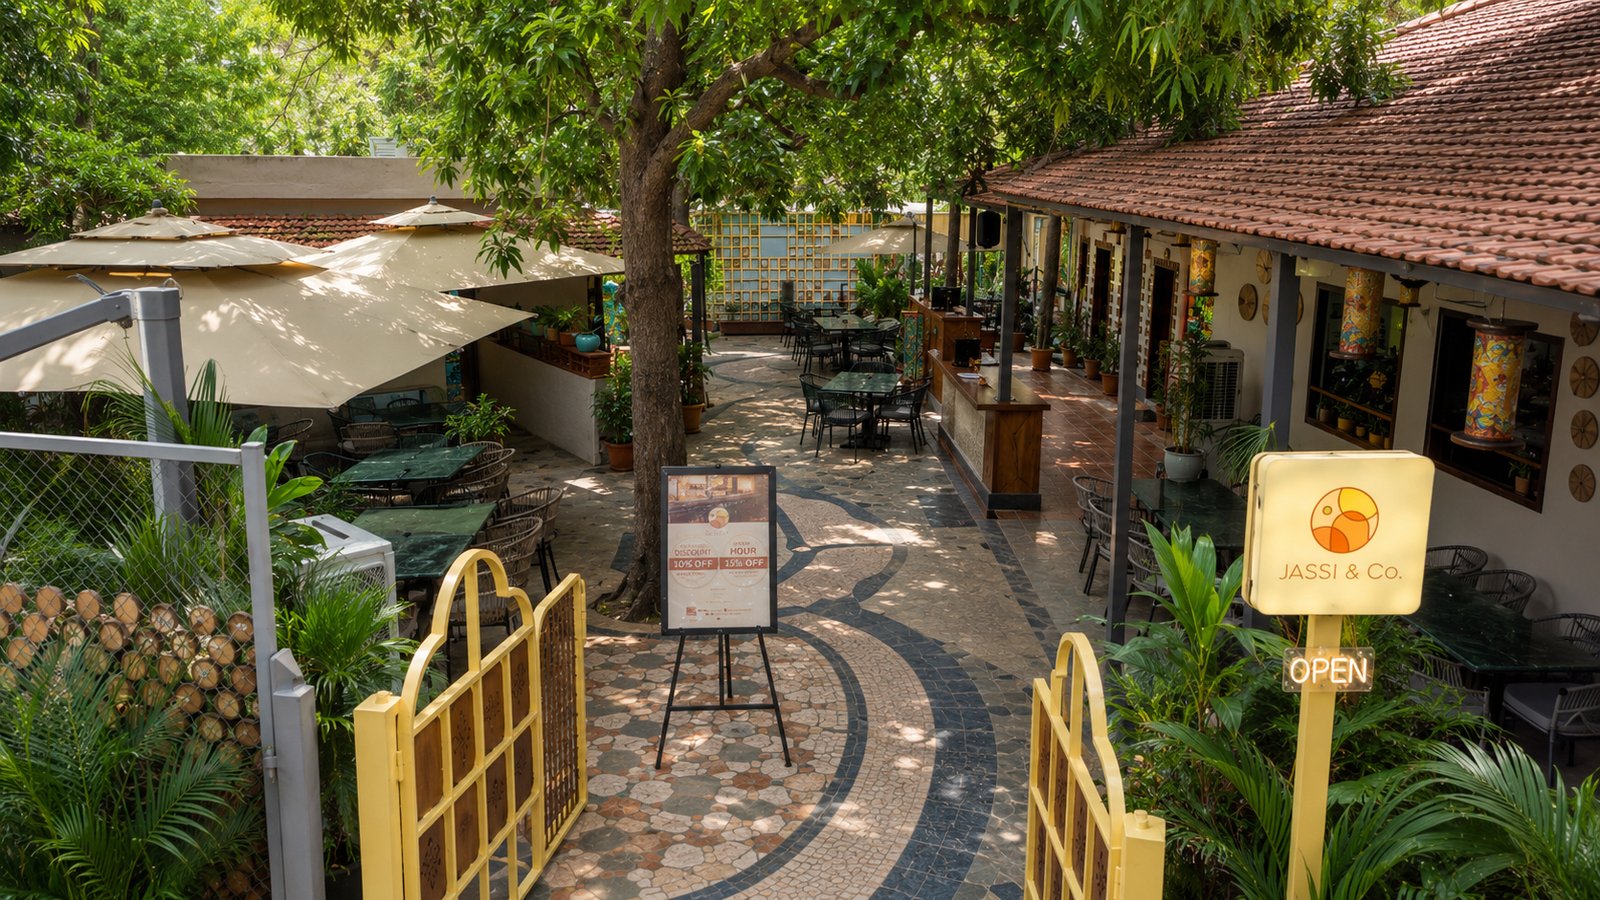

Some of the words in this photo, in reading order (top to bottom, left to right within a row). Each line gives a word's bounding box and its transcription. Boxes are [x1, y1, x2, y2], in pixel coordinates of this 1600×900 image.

[730, 547, 757, 555] HOUR
[674, 560, 693, 568] 10%
[694, 559, 713, 568] OFF
[745, 558, 764, 567] OFF
[1279, 563, 1337, 580] JASSI
[1345, 563, 1360, 580] &
[1367, 562, 1402, 580] Co.
[1290, 657, 1368, 684] OPEN
